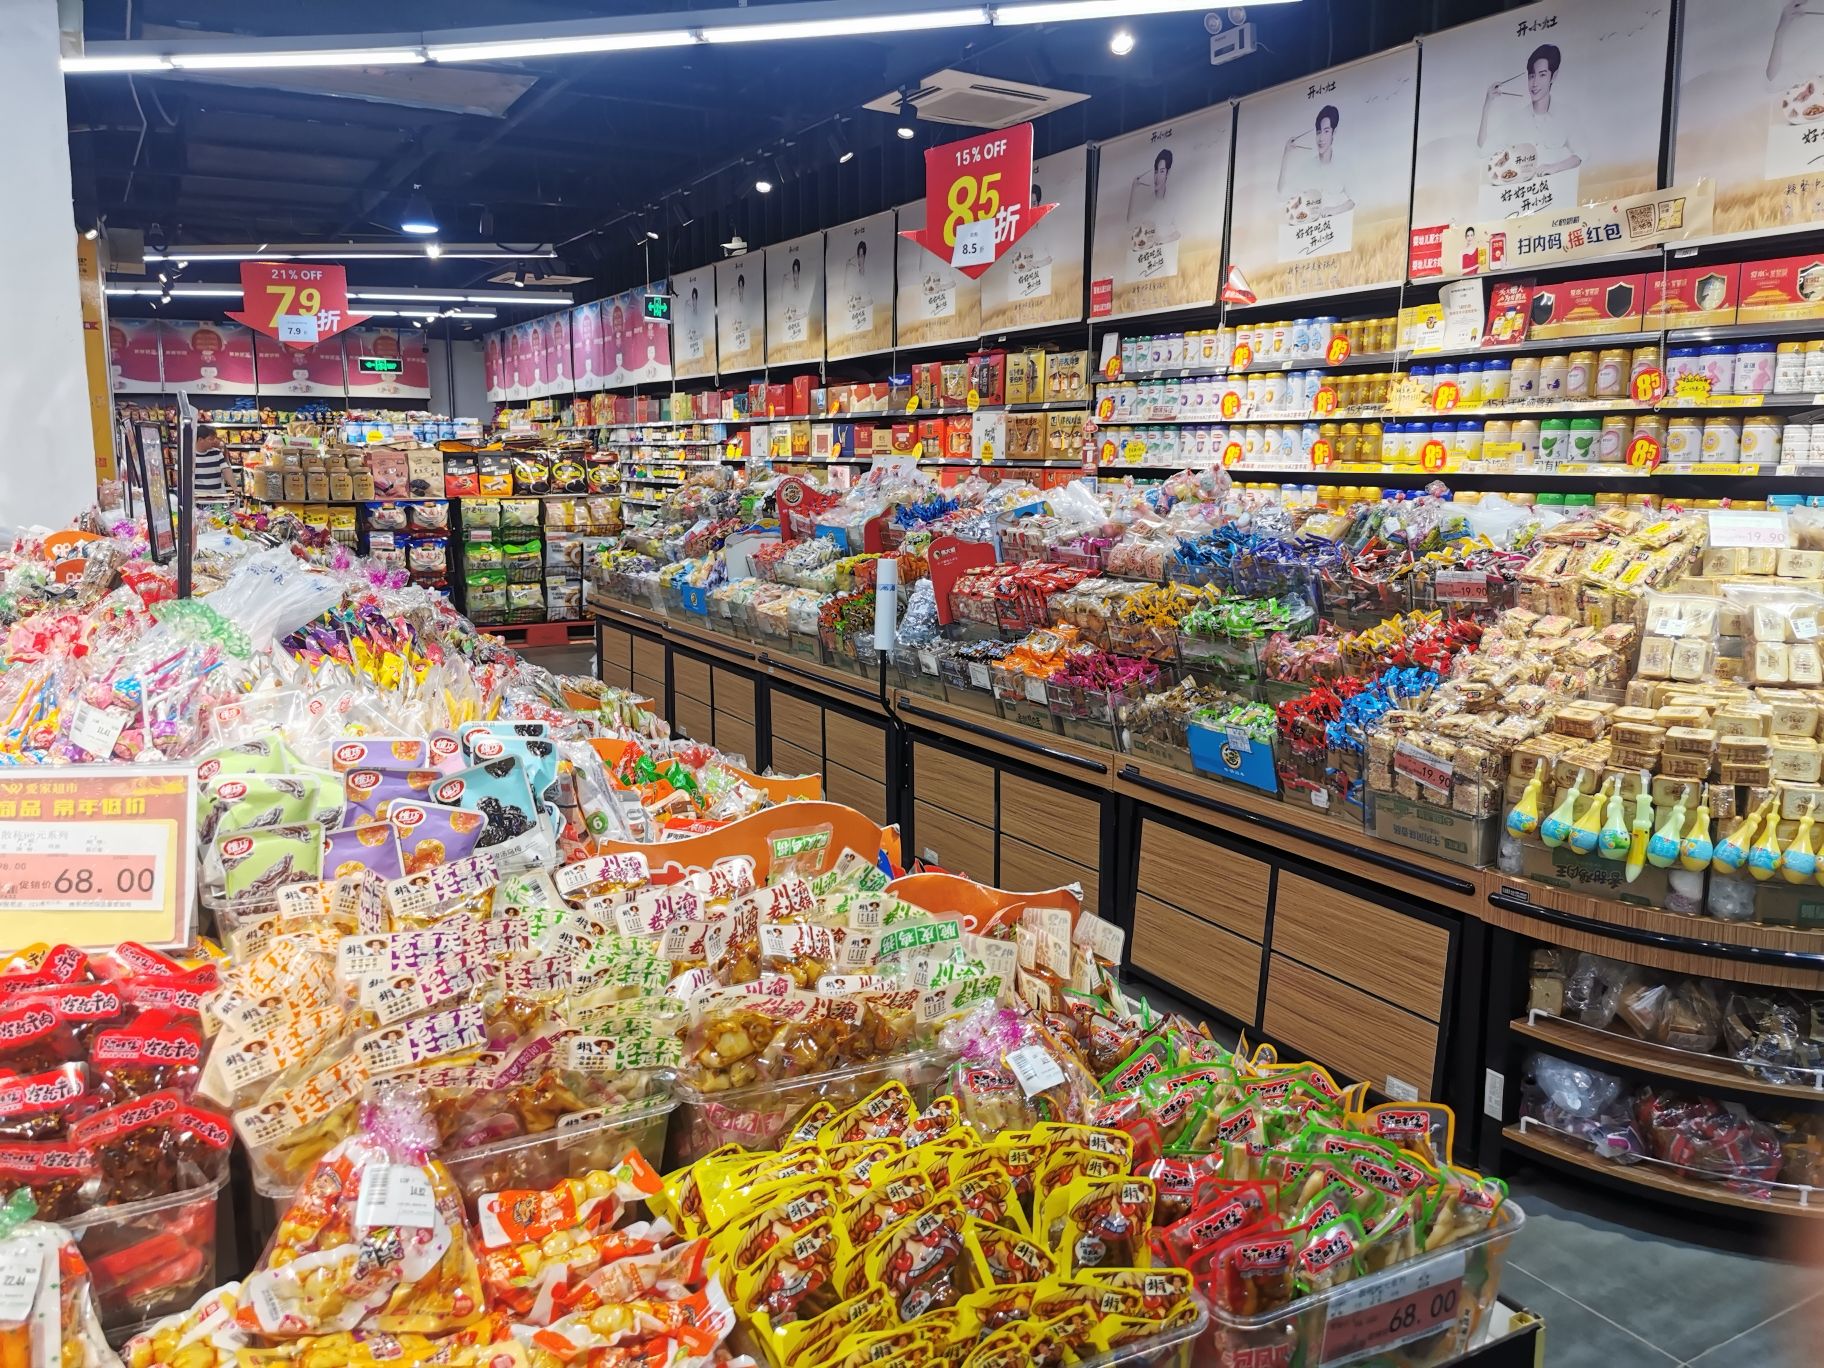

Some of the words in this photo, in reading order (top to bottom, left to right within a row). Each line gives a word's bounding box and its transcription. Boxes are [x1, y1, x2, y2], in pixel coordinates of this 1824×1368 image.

[955, 145, 981, 167] 15%
[984, 139, 1007, 160] OFF
[994, 203, 1021, 245] 折
[962, 243, 977, 255] 8.5
[1517, 223, 1622, 256] 扫内码摇红包
[271, 269, 298, 280] 21%
[300, 270, 323, 281] OFF
[266, 285, 321, 328] 79
[287, 327, 302, 335] 7.9
[317, 309, 341, 332] 折
[1461, 586, 1487, 596] 19.90
[1421, 766, 1450, 788] 19.90
[593, 816, 603, 830] 6
[602, 855, 642, 872] 川渝
[19, 880, 52, 890] 促销价
[54, 868, 155, 894] 68.00
[772, 879, 809, 899] 川渝
[655, 892, 698, 914] 川渝
[746, 977, 789, 996] 川渝
[60, 990, 118, 1013] 冷吃牛肉
[0, 1010, 54, 1038] 冷吃牛肉
[143, 1037, 199, 1060] 冷吃牛肉
[120, 1098, 178, 1126] 冷吃牛肉
[1390, 1288, 1457, 1333] 68.00
